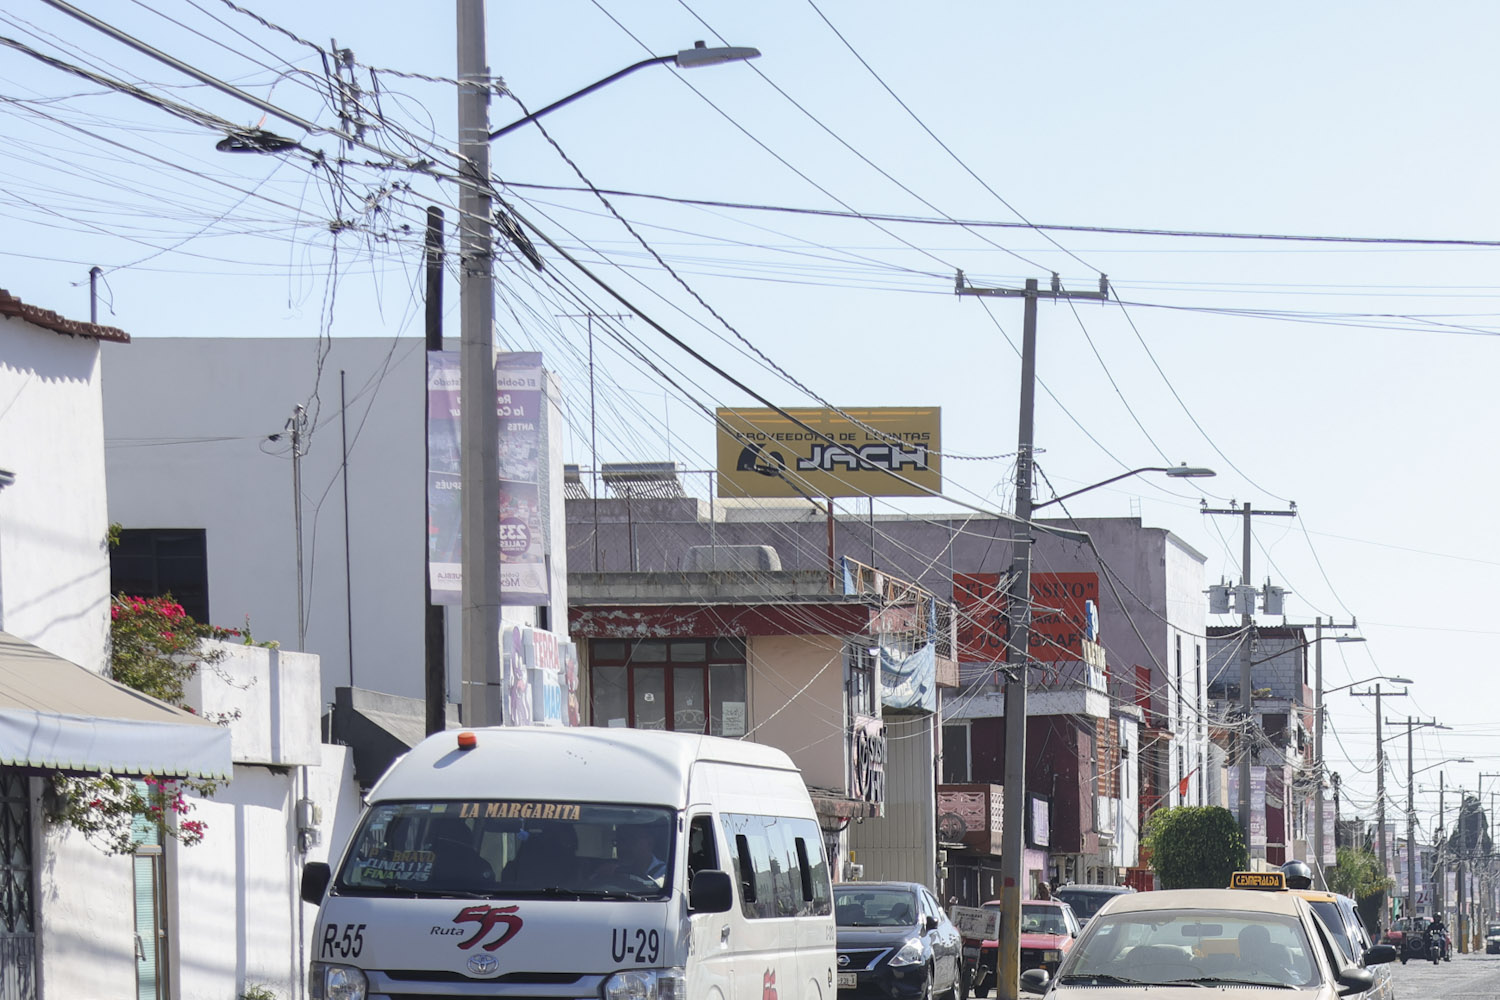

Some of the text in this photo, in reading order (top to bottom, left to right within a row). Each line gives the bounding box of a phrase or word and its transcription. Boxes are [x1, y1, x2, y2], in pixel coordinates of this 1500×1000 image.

[839, 432, 857, 441] DE
[797, 443, 929, 472] JACH
[459, 802, 581, 820] LA MARGARITA
[321, 923, 367, 959] R-55
[429, 925, 465, 937] Ruta
[612, 927, 659, 964] U-29
